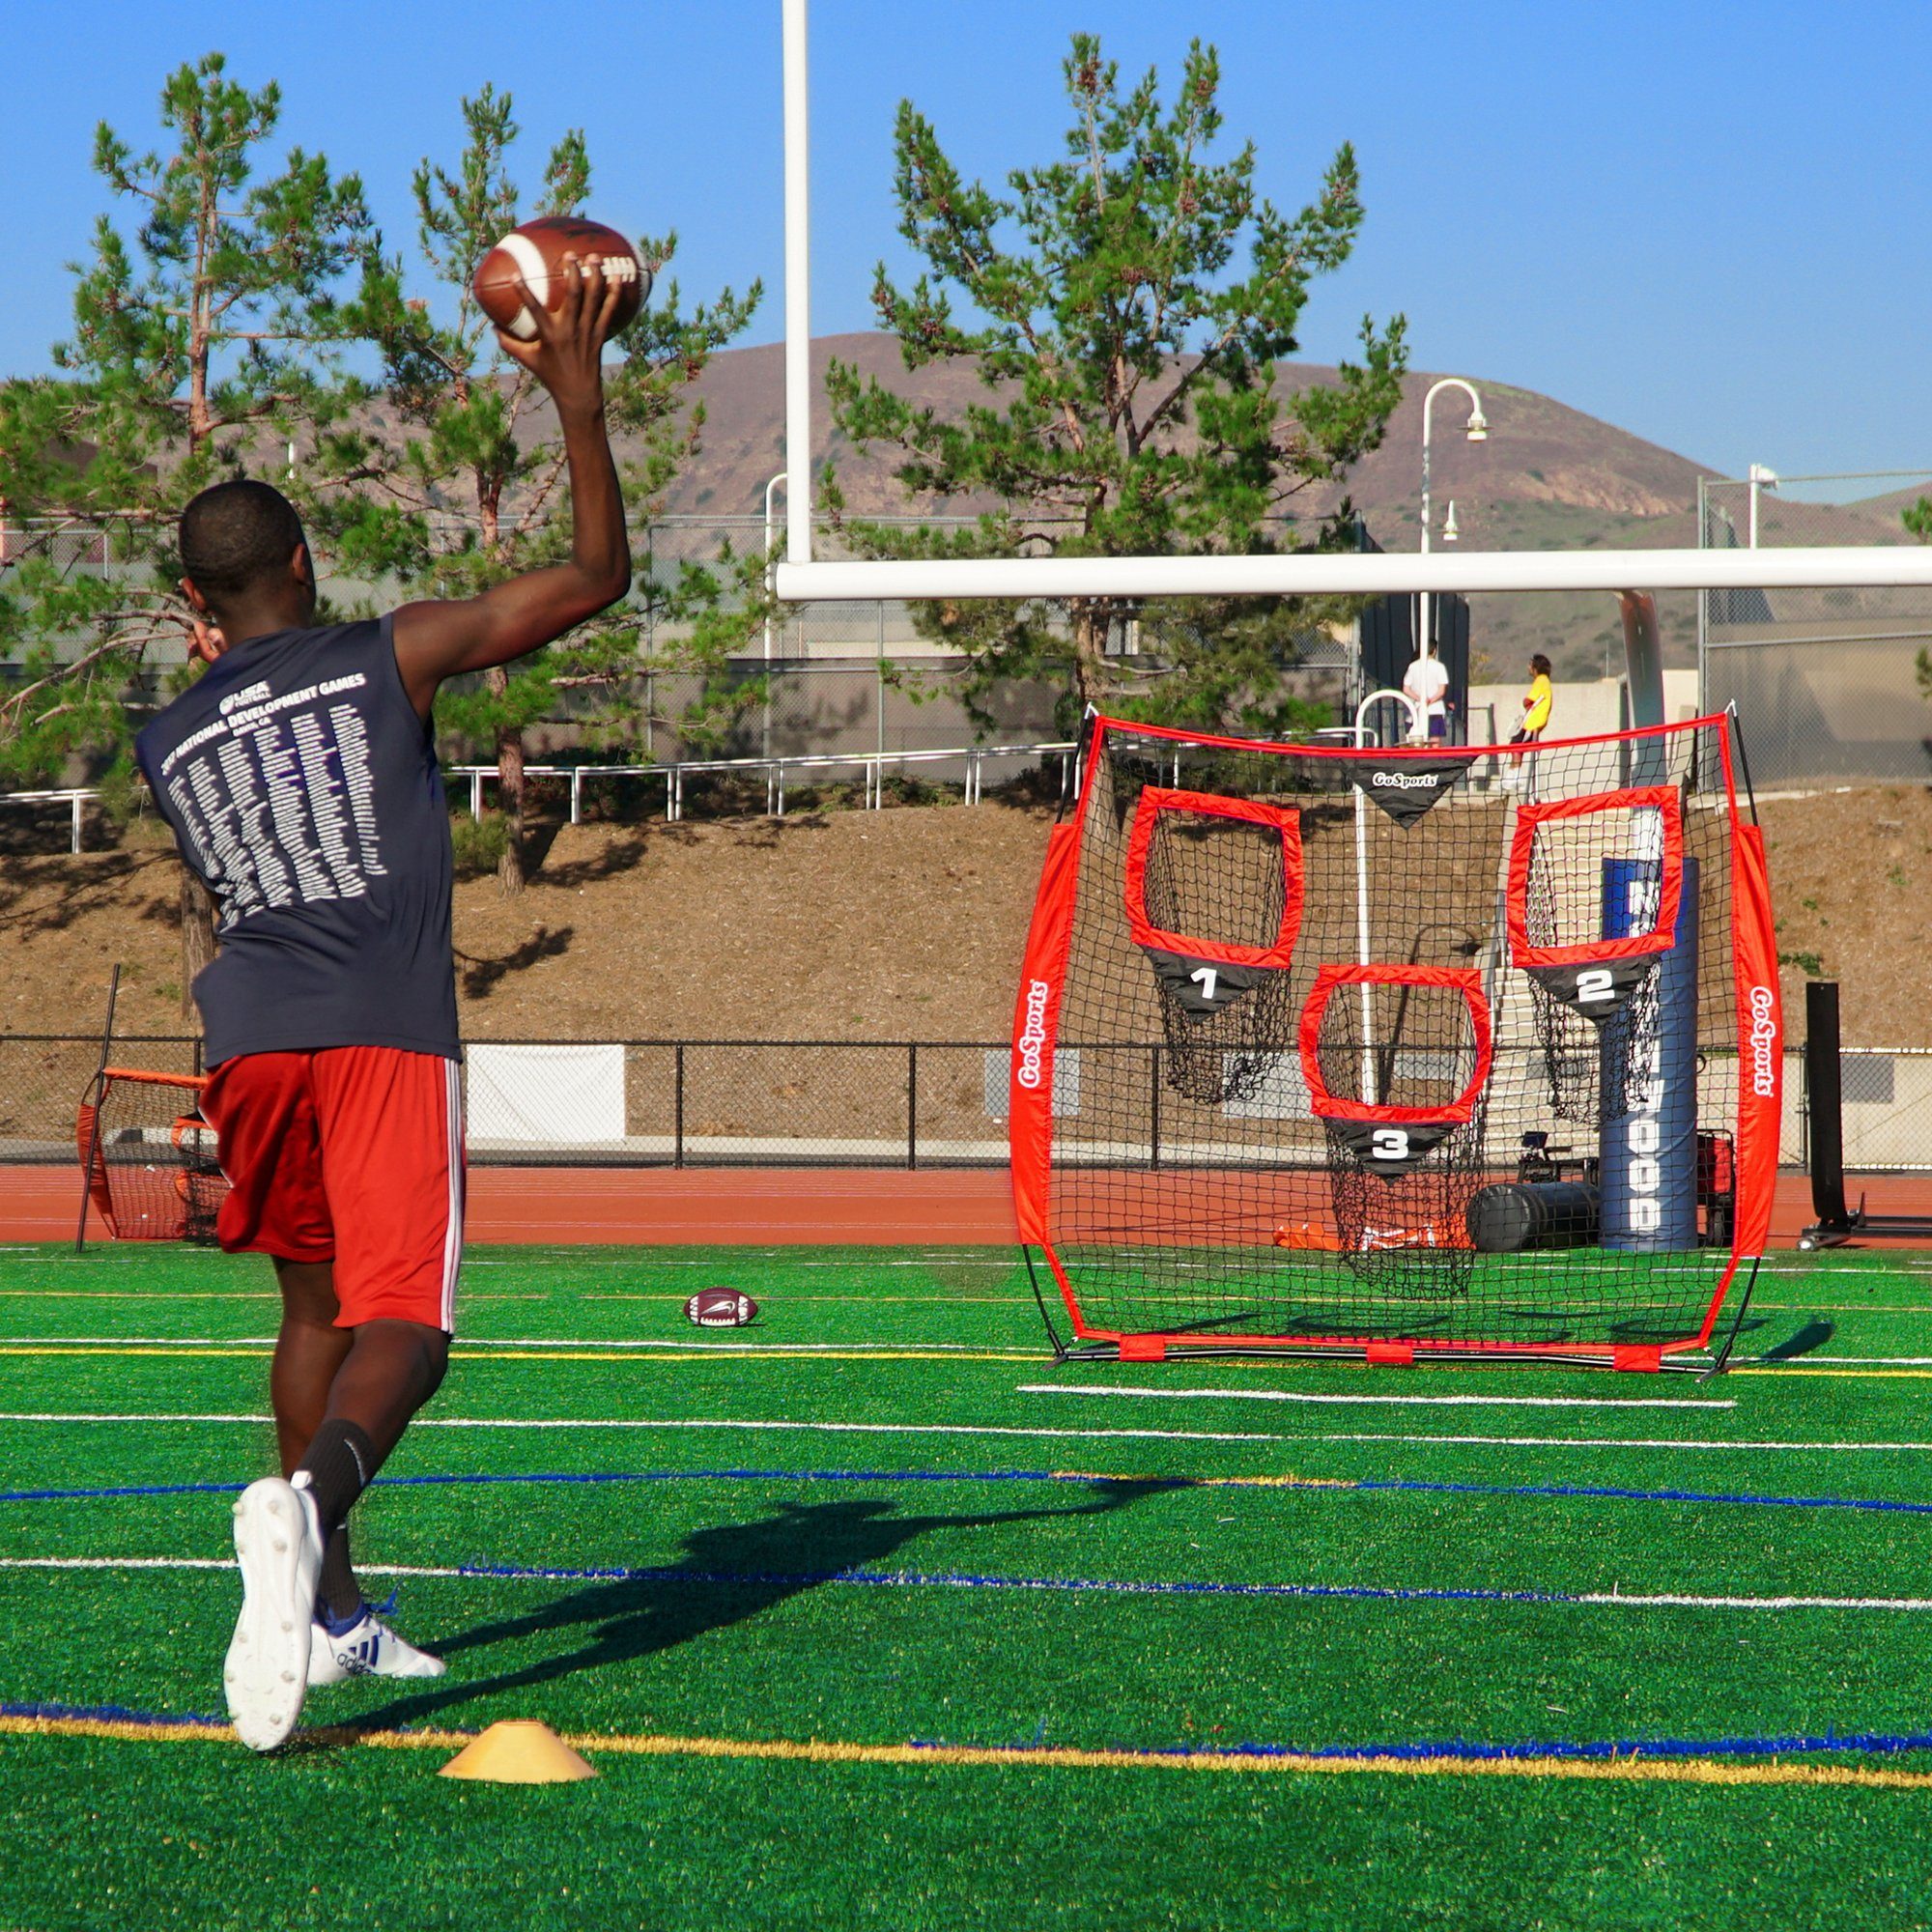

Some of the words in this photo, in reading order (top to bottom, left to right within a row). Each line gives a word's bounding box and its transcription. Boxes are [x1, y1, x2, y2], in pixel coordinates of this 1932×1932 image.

[234, 680, 270, 701] USA
[176, 720, 229, 758] NATIONAL
[227, 686, 318, 728] DEVELOPMENT
[319, 673, 366, 696] GAMES
[1373, 772, 1438, 789] GoSports
[1190, 967, 1217, 999] 1
[1577, 970, 1615, 1003] 2
[1018, 980, 1048, 1089] GoSports
[1749, 985, 1776, 1096] GoSports
[1372, 1128, 1409, 1159] 3
